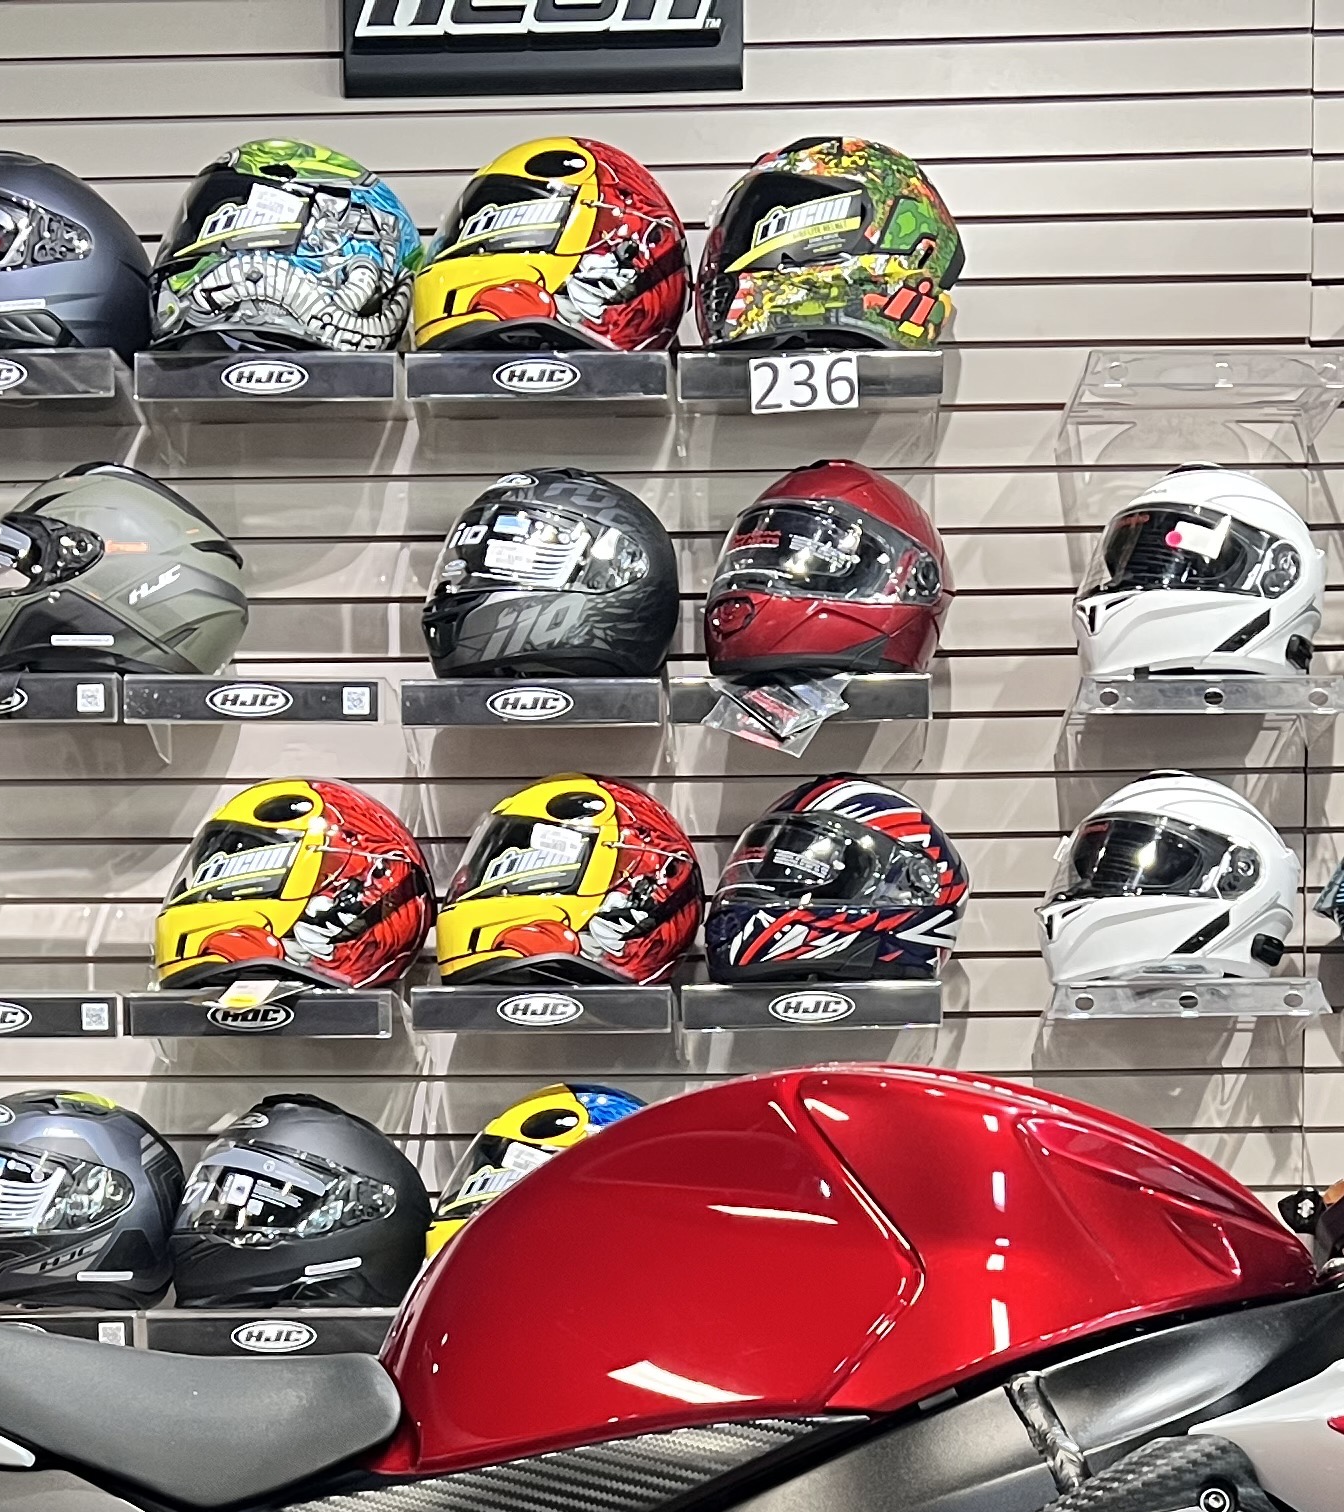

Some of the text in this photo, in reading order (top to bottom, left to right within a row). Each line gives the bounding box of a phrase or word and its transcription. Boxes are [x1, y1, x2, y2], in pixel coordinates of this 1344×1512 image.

[234, 369, 295, 383] HJC
[507, 368, 568, 385] HJC
[752, 357, 856, 412] 236
[129, 564, 181, 605] HJC
[220, 693, 279, 710] HJC
[500, 696, 561, 710] HJC
[511, 1001, 571, 1017] HJC
[782, 1000, 842, 1015] HJC
[40, 1242, 94, 1272] HJC
[245, 1330, 304, 1343] HJC
